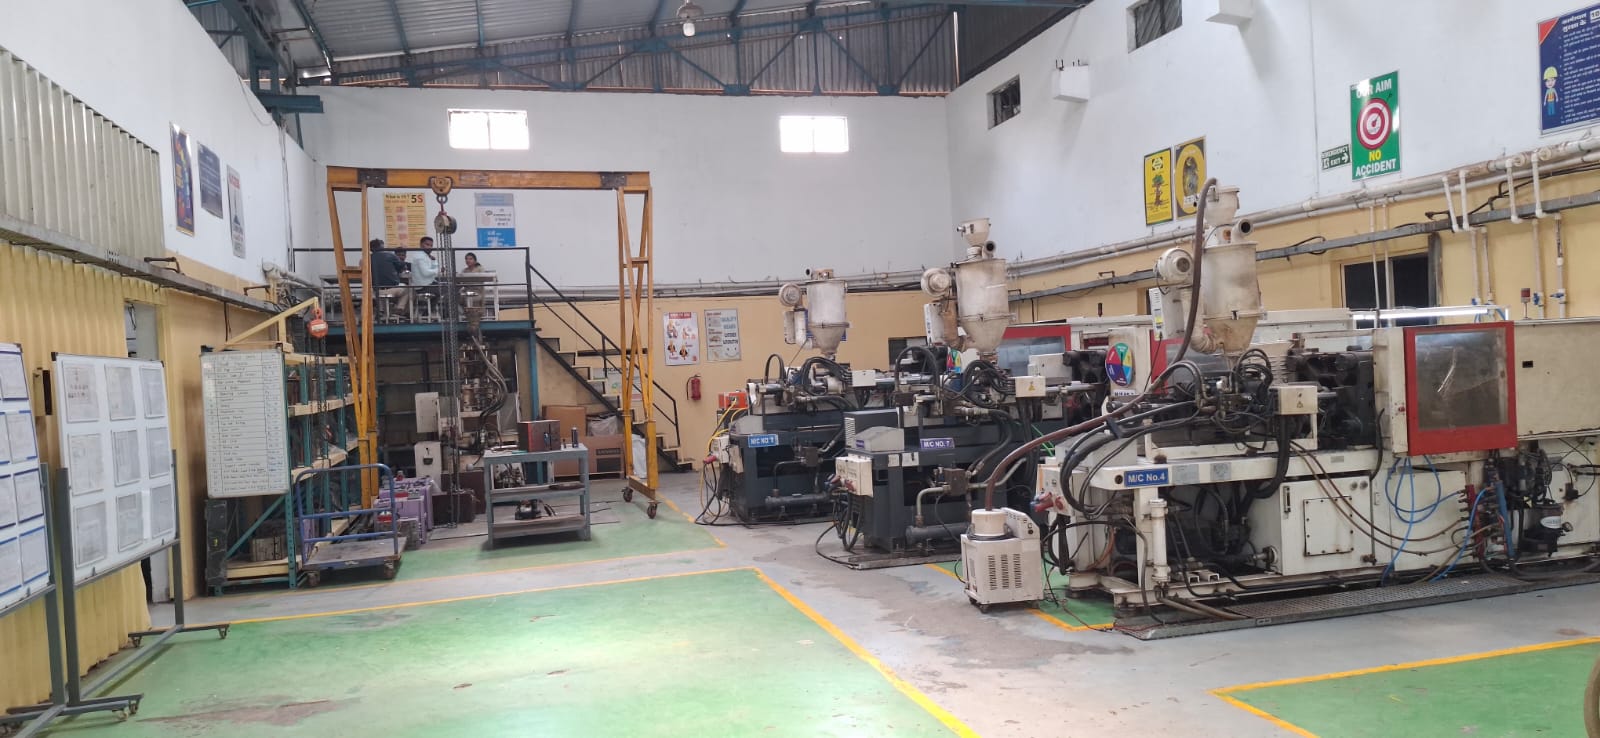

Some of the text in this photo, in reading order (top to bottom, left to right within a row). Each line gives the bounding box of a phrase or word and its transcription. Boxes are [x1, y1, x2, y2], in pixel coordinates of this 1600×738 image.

[1375, 78, 1392, 94] AIM
[1369, 150, 1381, 162] NO
[1356, 159, 1397, 177] ACCIDENT
[411, 194, 423, 204] 5S
[1128, 474, 1144, 482] M/C
